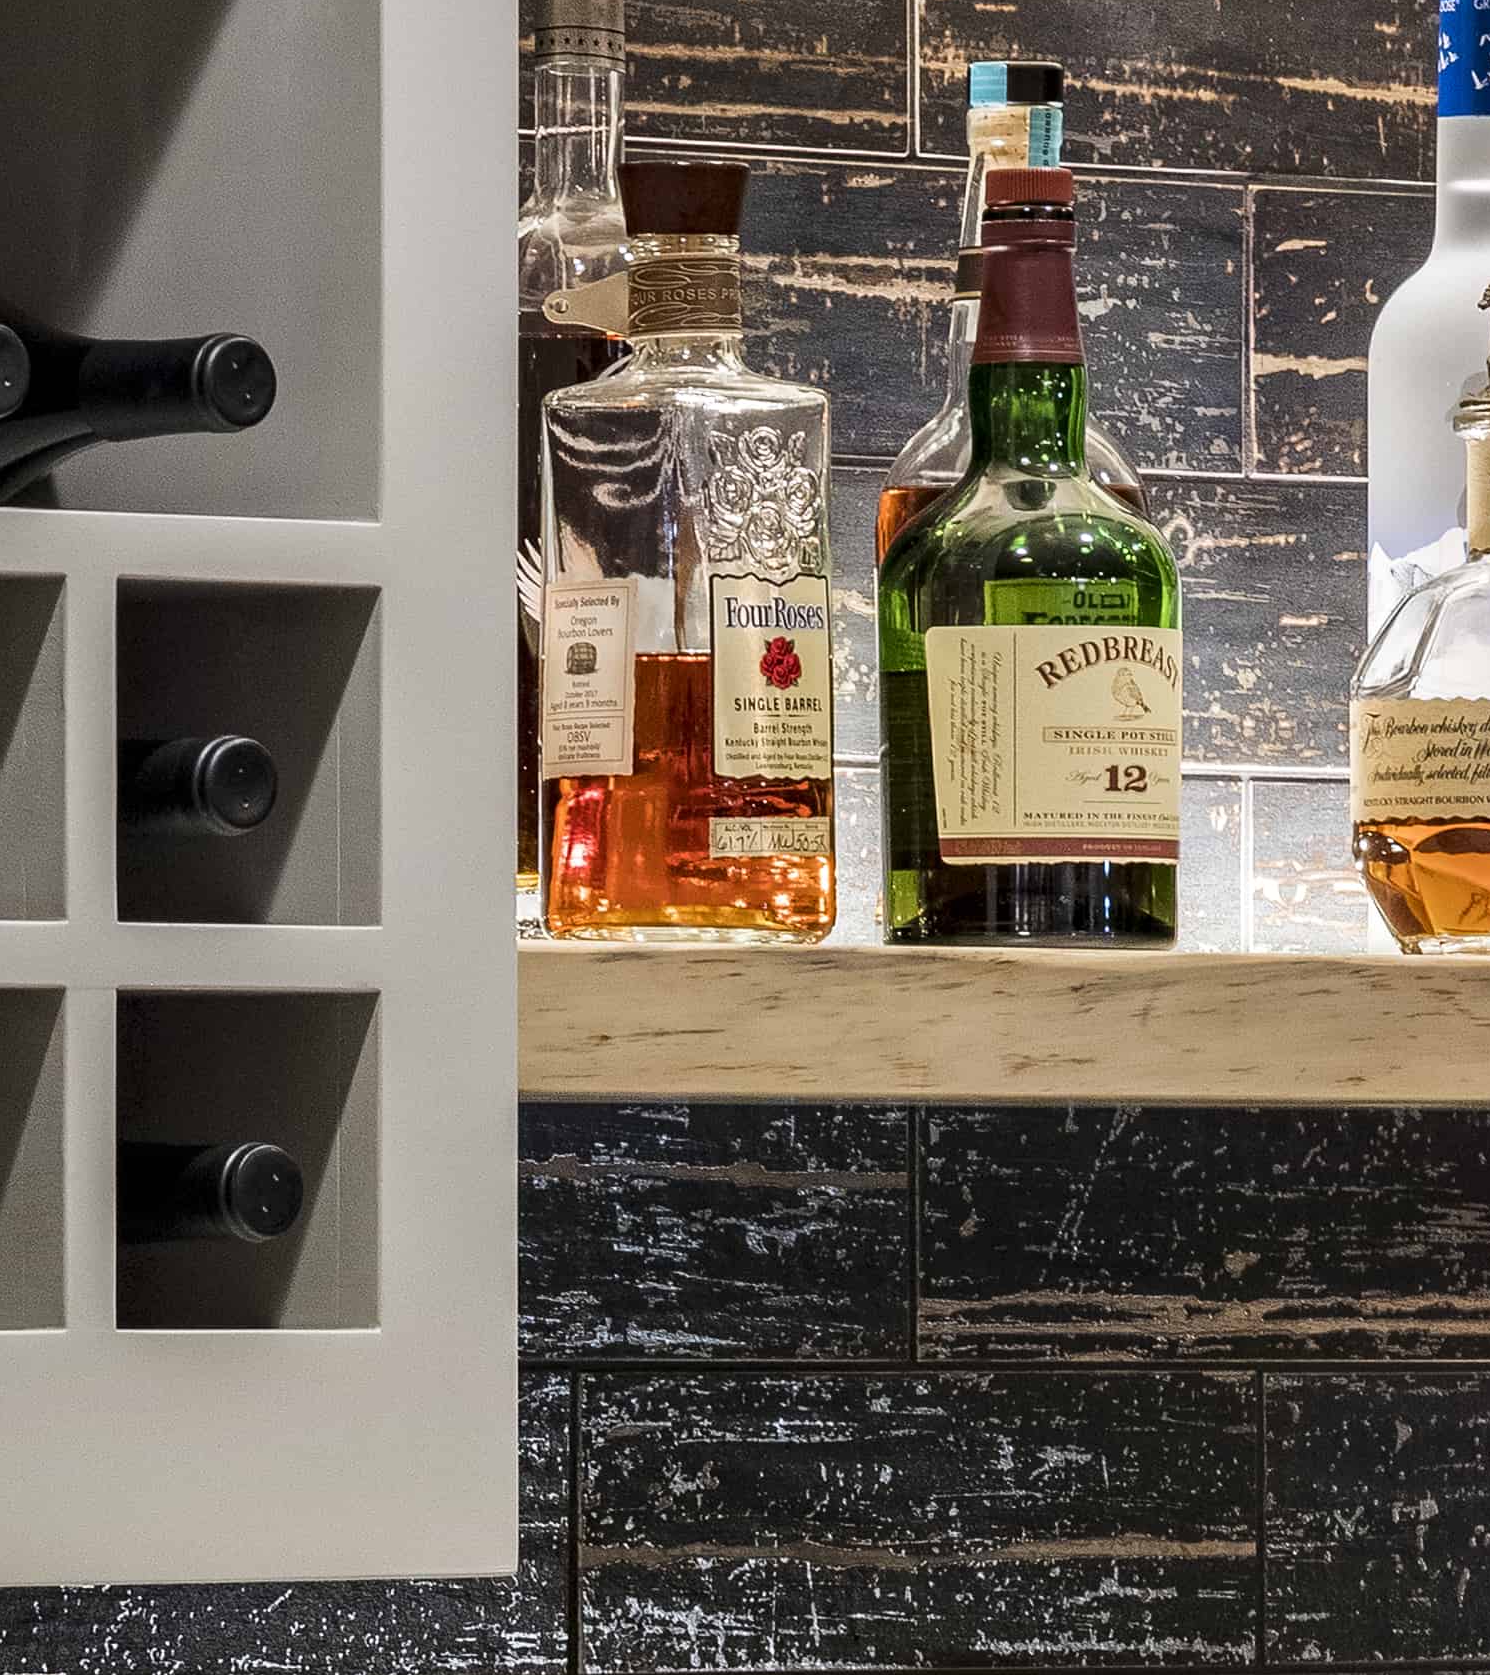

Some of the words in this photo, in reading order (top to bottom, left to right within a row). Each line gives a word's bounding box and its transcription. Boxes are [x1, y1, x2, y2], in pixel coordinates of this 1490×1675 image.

[663, 289, 717, 301] ROSES
[725, 596, 773, 629] Four
[774, 598, 824, 631] Roses
[1035, 635, 1178, 690] REDBREAST
[735, 698, 780, 712] SINGLE
[785, 698, 822, 712] BARREL
[754, 723, 779, 734] Barrel
[1054, 730, 1115, 740] SINGLE
[1121, 731, 1146, 741] POT
[1150, 731, 1174, 742] STILL
[1105, 765, 1148, 792] 12
[1395, 795, 1433, 805] STRAIGHT
[1435, 795, 1484, 804] BOURBON
[1023, 811, 1083, 820] MATURED
[1088, 812, 1099, 820] IN
[1104, 812, 1122, 820] THE
